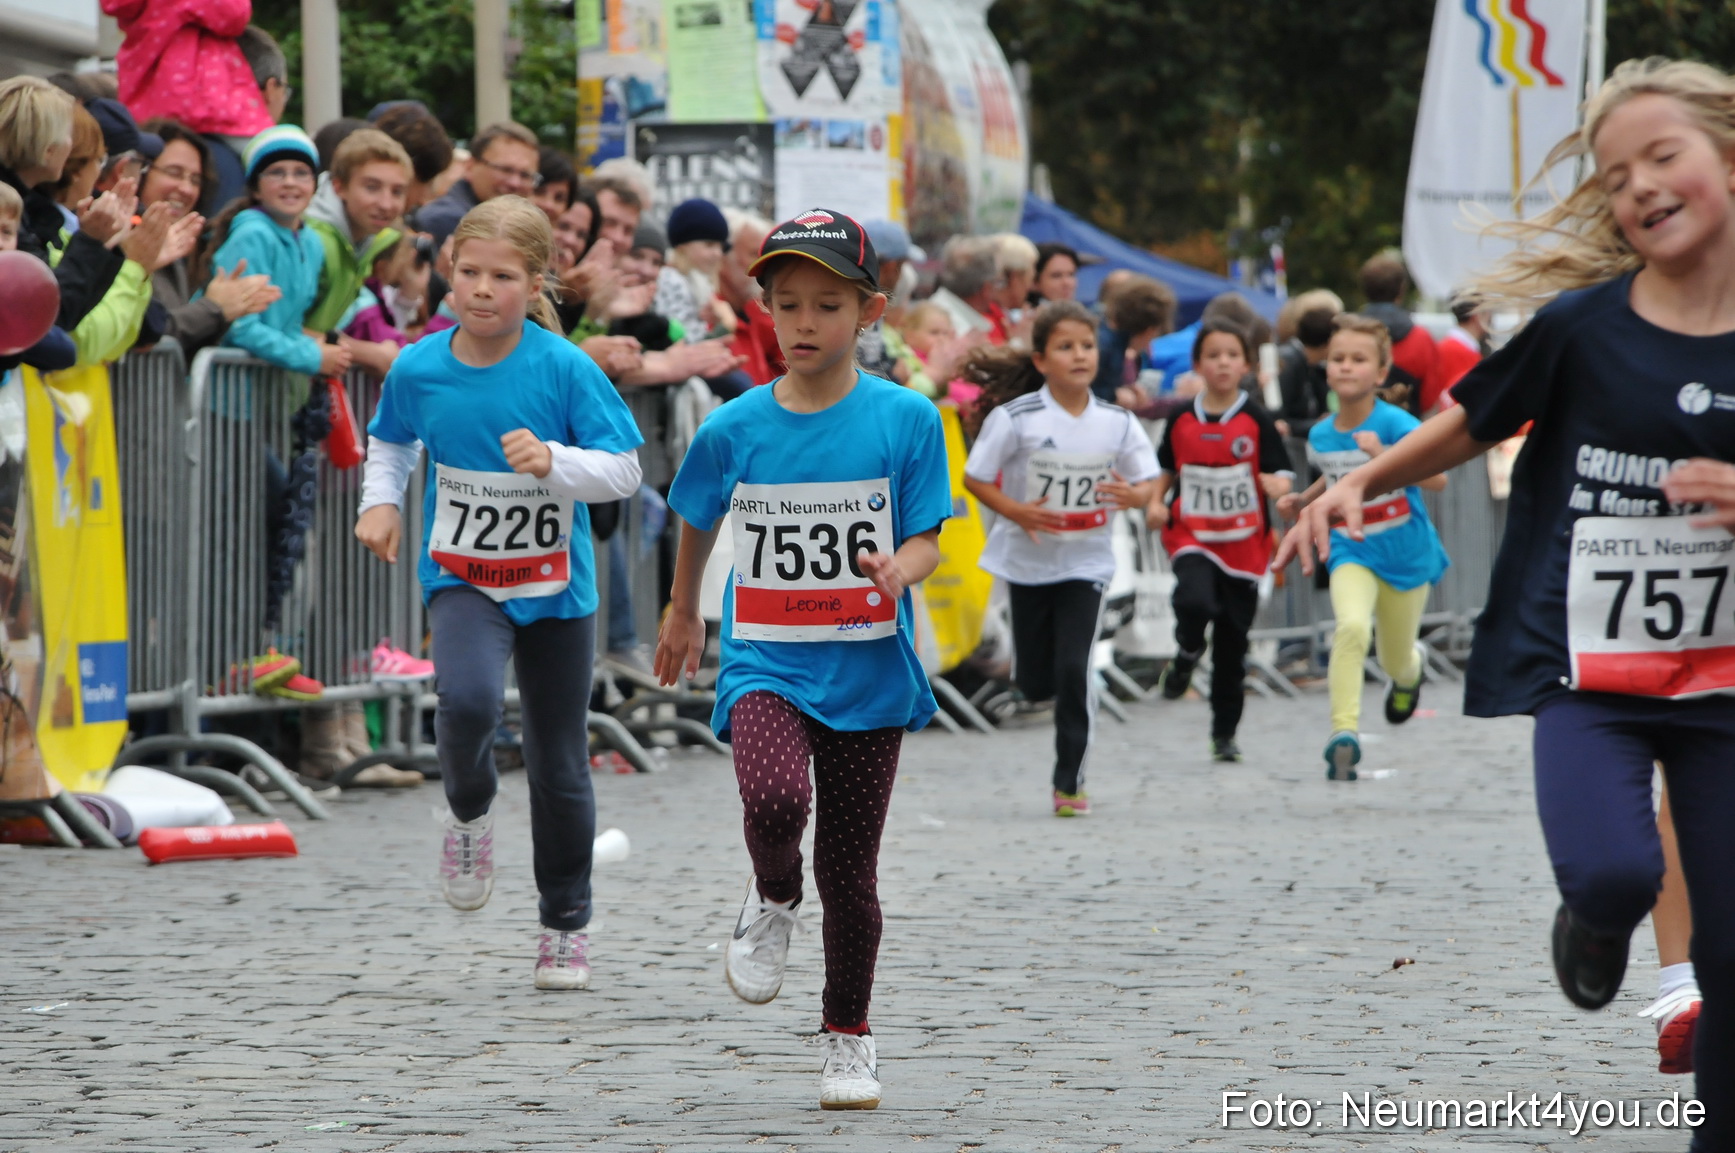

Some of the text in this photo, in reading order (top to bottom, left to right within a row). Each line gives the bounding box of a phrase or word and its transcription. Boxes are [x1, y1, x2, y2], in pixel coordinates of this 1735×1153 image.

[439, 477, 479, 497] PARTL
[1188, 483, 1249, 512] 7166
[732, 497, 862, 515] PARTL Neumarkt
[1568, 483, 1594, 511] im
[1600, 490, 1660, 516] Haus
[449, 499, 560, 551] 7226
[745, 521, 879, 581] 7536
[1575, 539, 1648, 557] PARTL
[467, 562, 532, 586] Mirjam
[785, 596, 843, 612] Leonie
[1594, 565, 1735, 641] 757
[834, 615, 873, 631] 2006
